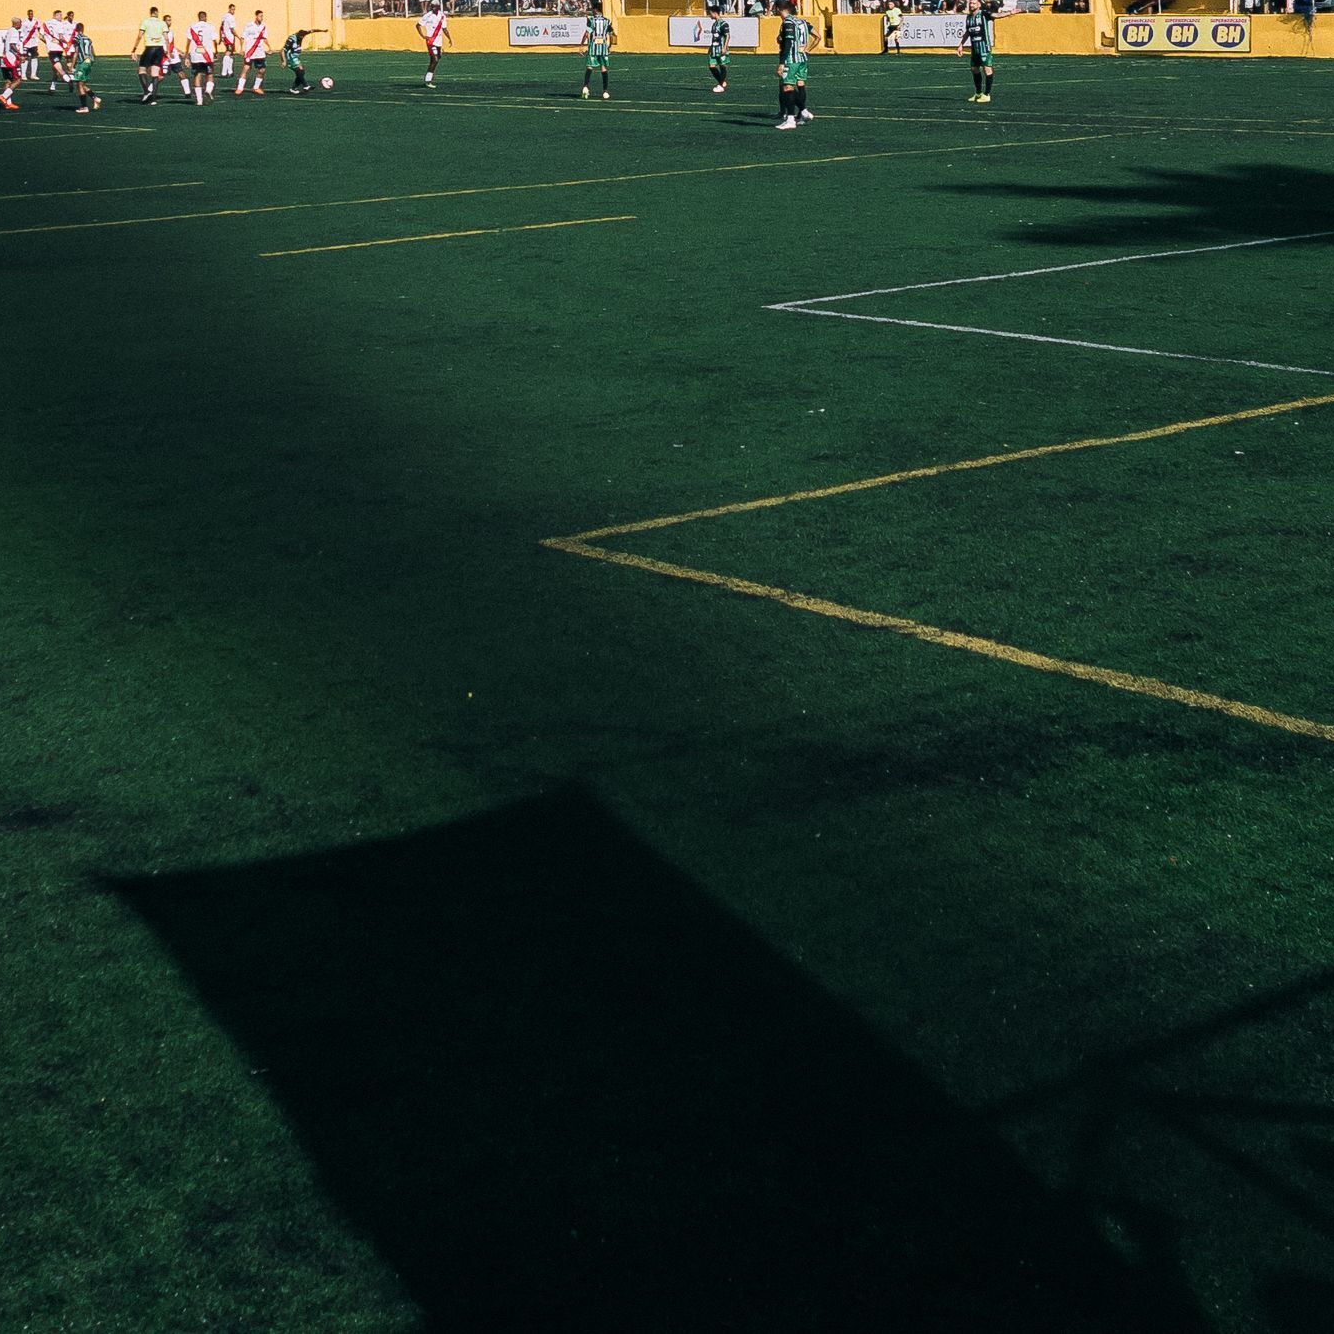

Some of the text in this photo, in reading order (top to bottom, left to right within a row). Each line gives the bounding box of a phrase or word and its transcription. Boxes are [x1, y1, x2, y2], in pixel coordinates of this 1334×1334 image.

[515, 25, 540, 37] CEMIG
[1126, 25, 1150, 43] BH
[1170, 25, 1195, 43] BH
[1216, 25, 1242, 43] BH
